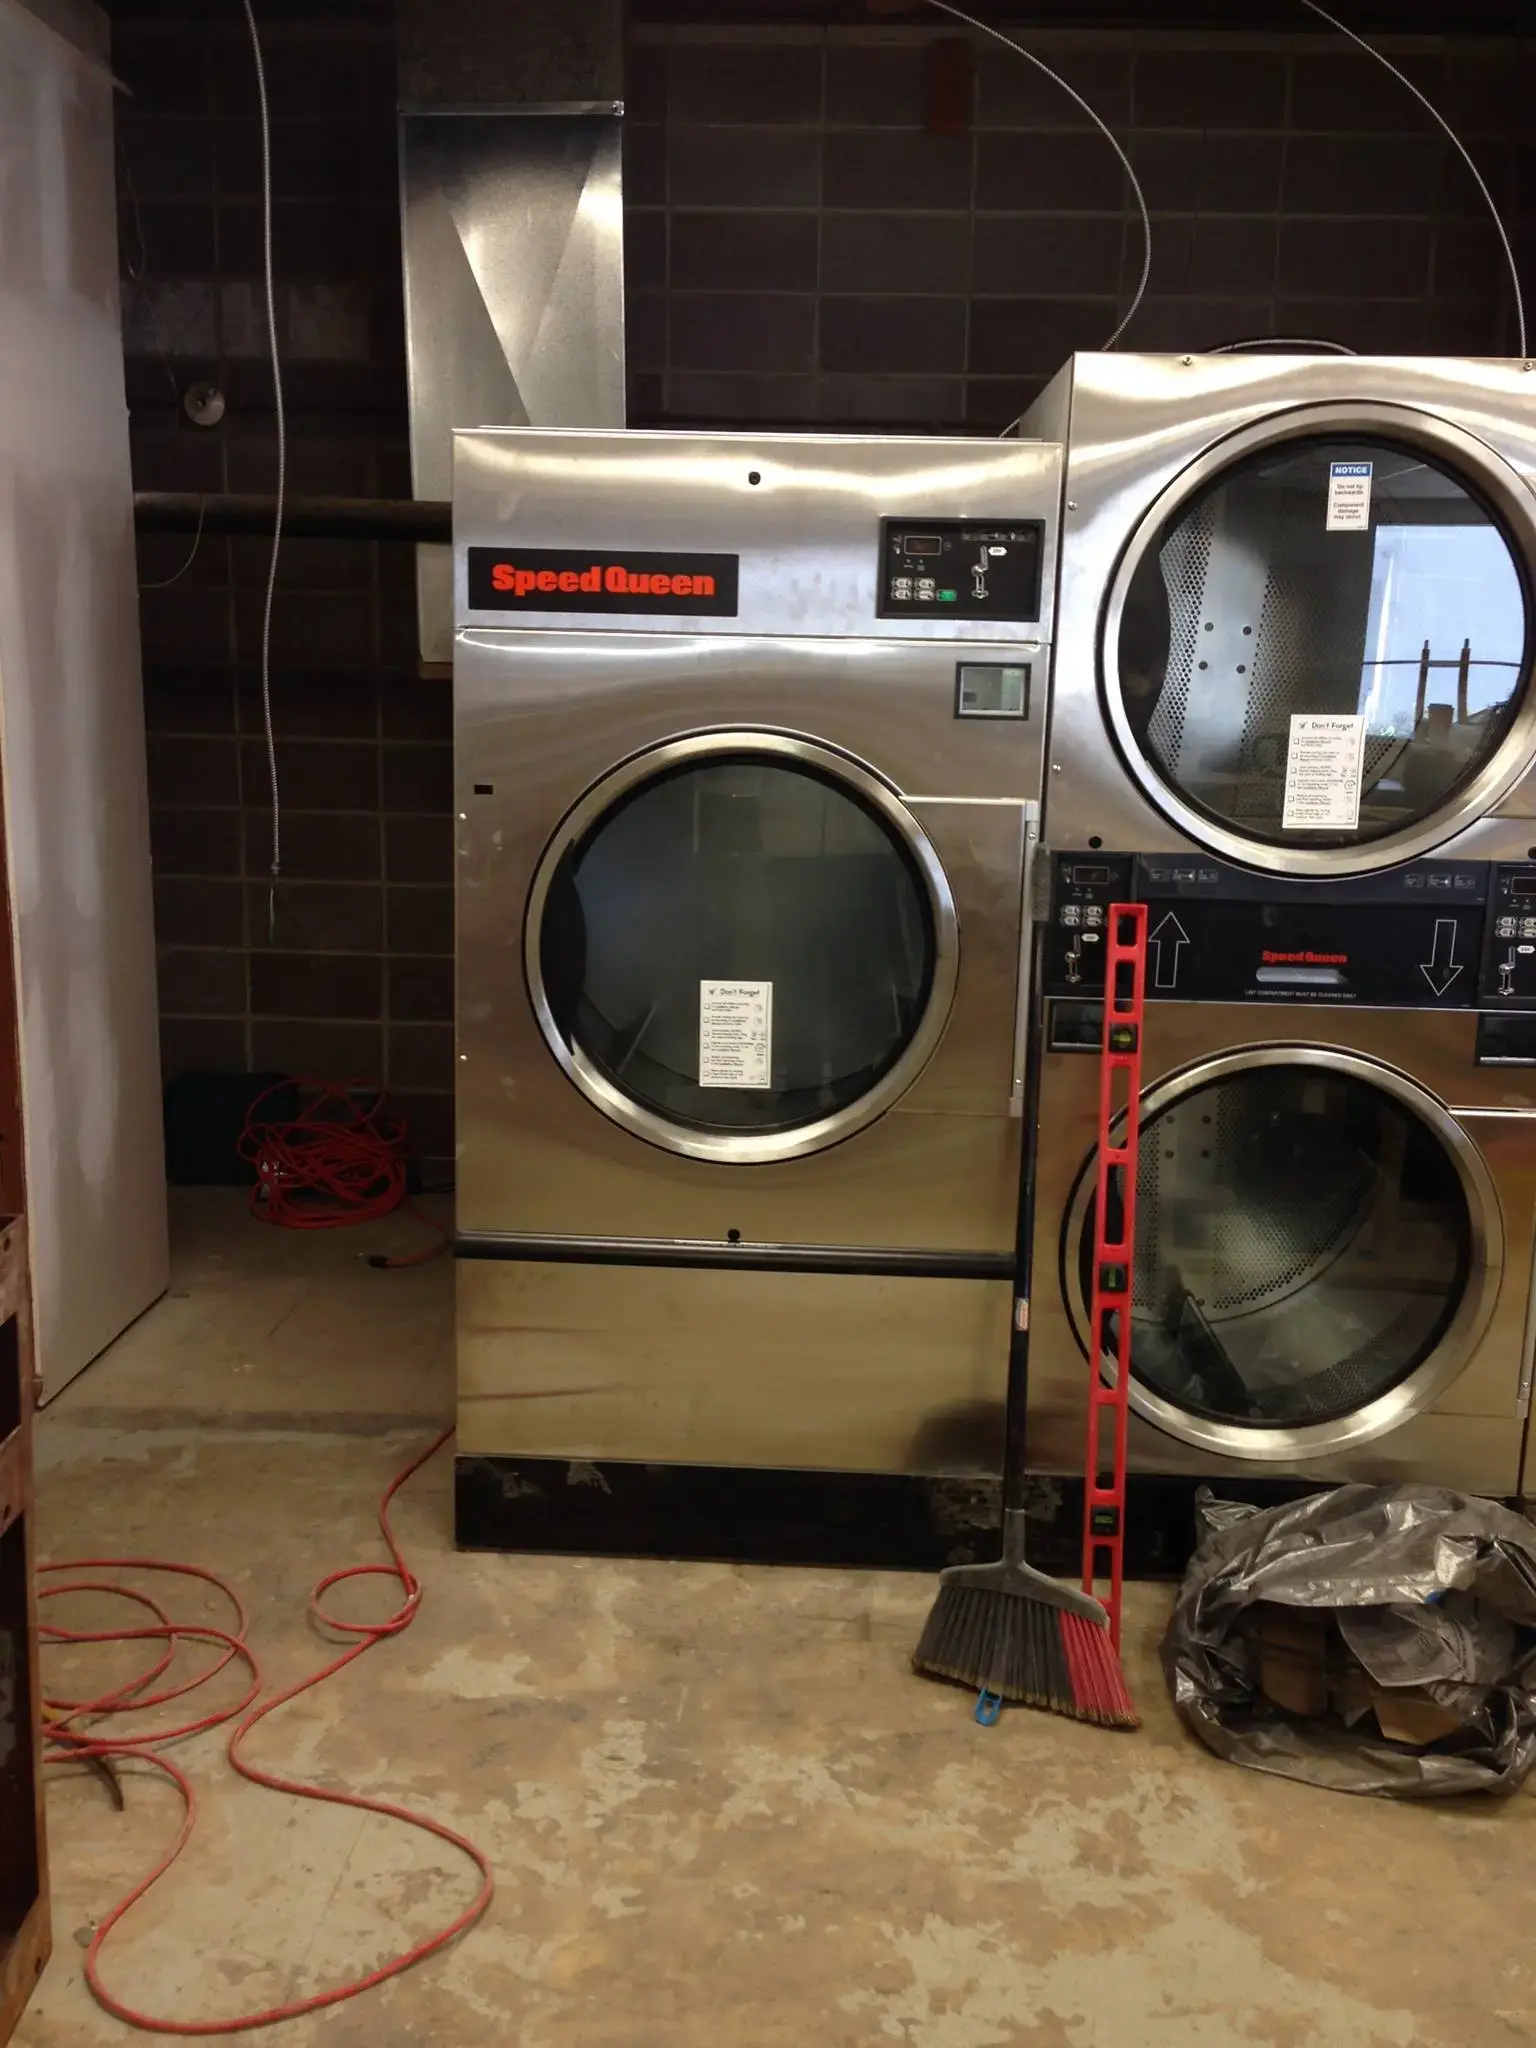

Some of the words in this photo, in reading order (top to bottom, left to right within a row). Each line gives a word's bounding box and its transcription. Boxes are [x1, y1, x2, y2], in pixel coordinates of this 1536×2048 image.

[1335, 466, 1368, 474] NOTICE
[492, 564, 602, 596] Speed
[605, 566, 715, 596] Queen
[1331, 722, 1354, 731] Forget
[1262, 951, 1304, 963] Speed
[1305, 951, 1348, 963] Queen
[739, 989, 760, 997] Forget
